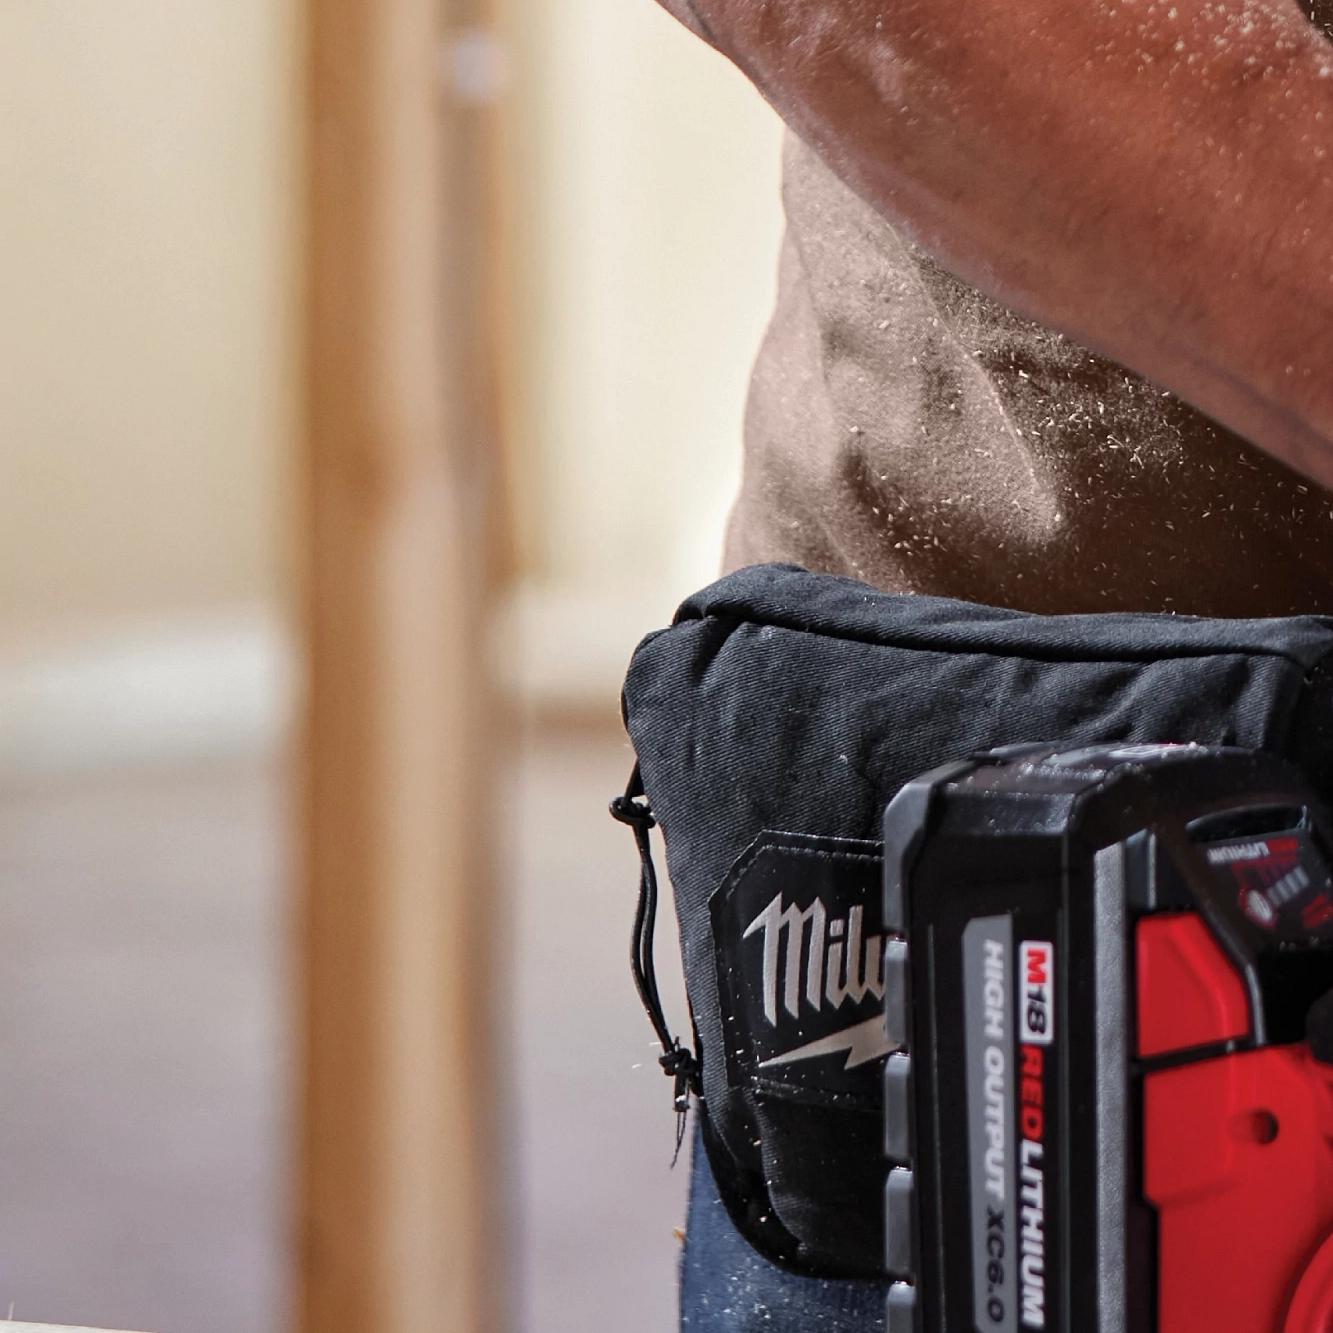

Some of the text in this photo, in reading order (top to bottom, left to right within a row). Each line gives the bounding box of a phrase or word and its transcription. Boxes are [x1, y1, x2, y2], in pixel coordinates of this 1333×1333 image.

[983, 939, 1005, 1039] HIGH
[983, 1045, 1005, 1203] OUTPUT
[1019, 947, 1047, 1329] M18 REDLITHIUM
